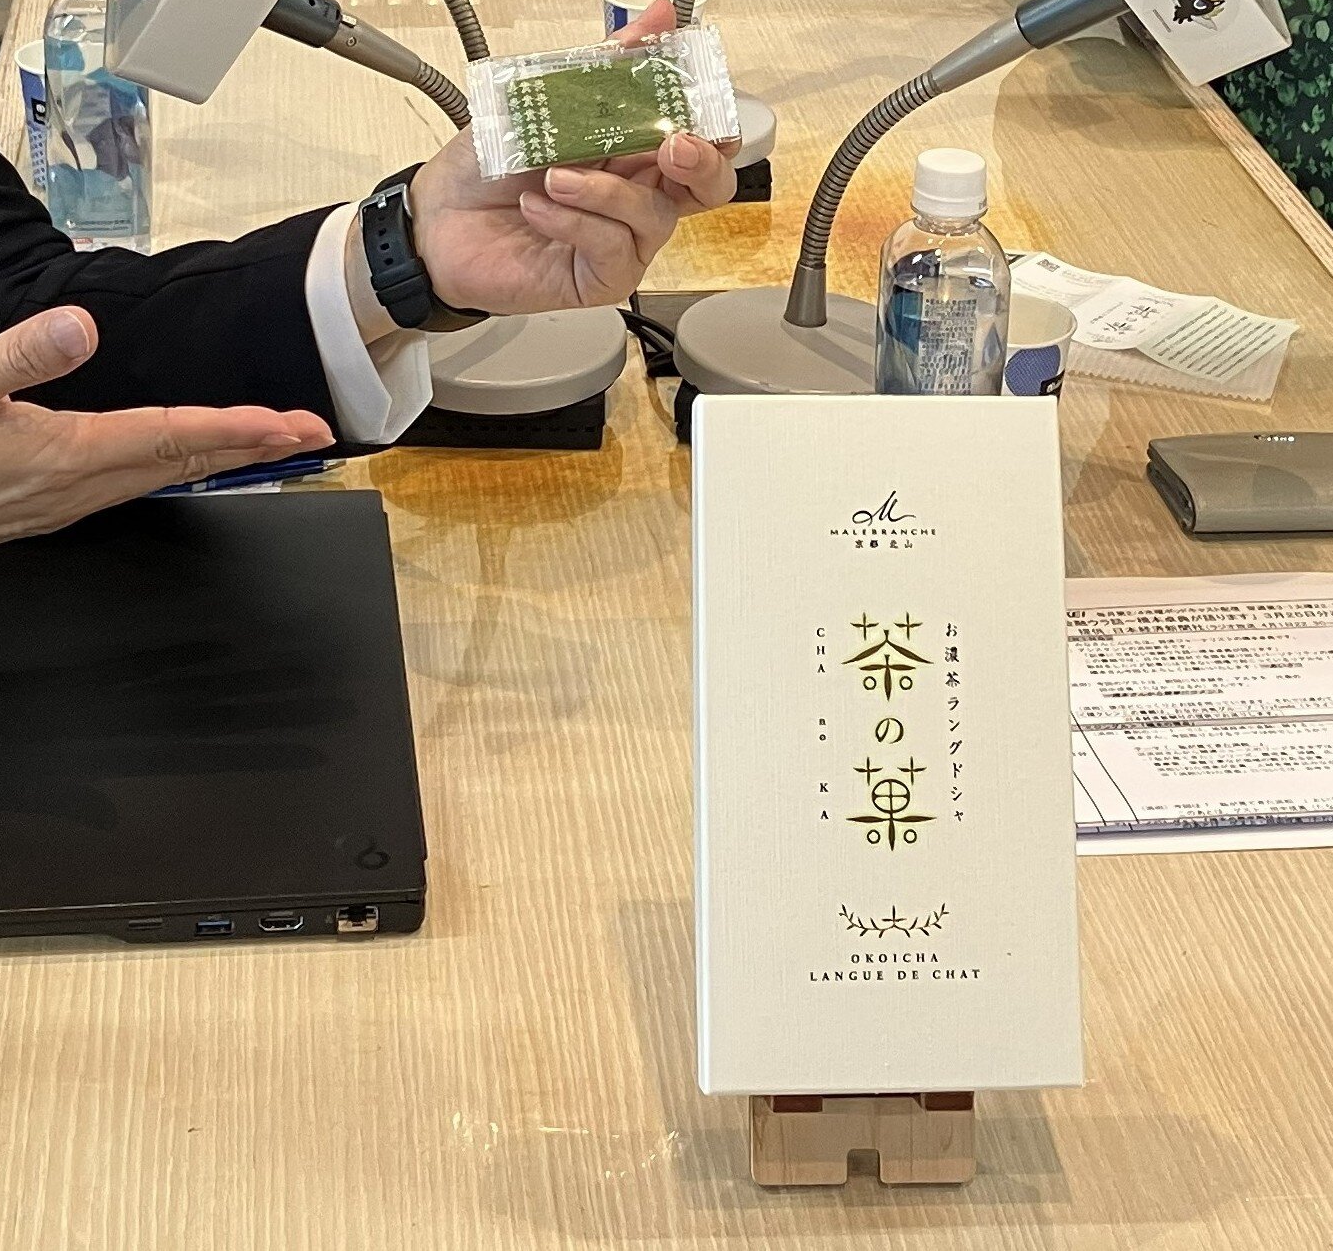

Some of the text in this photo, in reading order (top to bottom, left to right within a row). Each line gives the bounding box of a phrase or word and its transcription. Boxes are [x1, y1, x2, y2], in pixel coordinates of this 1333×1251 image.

[816, 627, 827, 674] CHA
[818, 718, 827, 742] no
[944, 622, 964, 822] お濃茶ラングドシャ
[850, 953, 939, 964] OKOICHA
[809, 968, 981, 982] LANGUE DE CHAT
